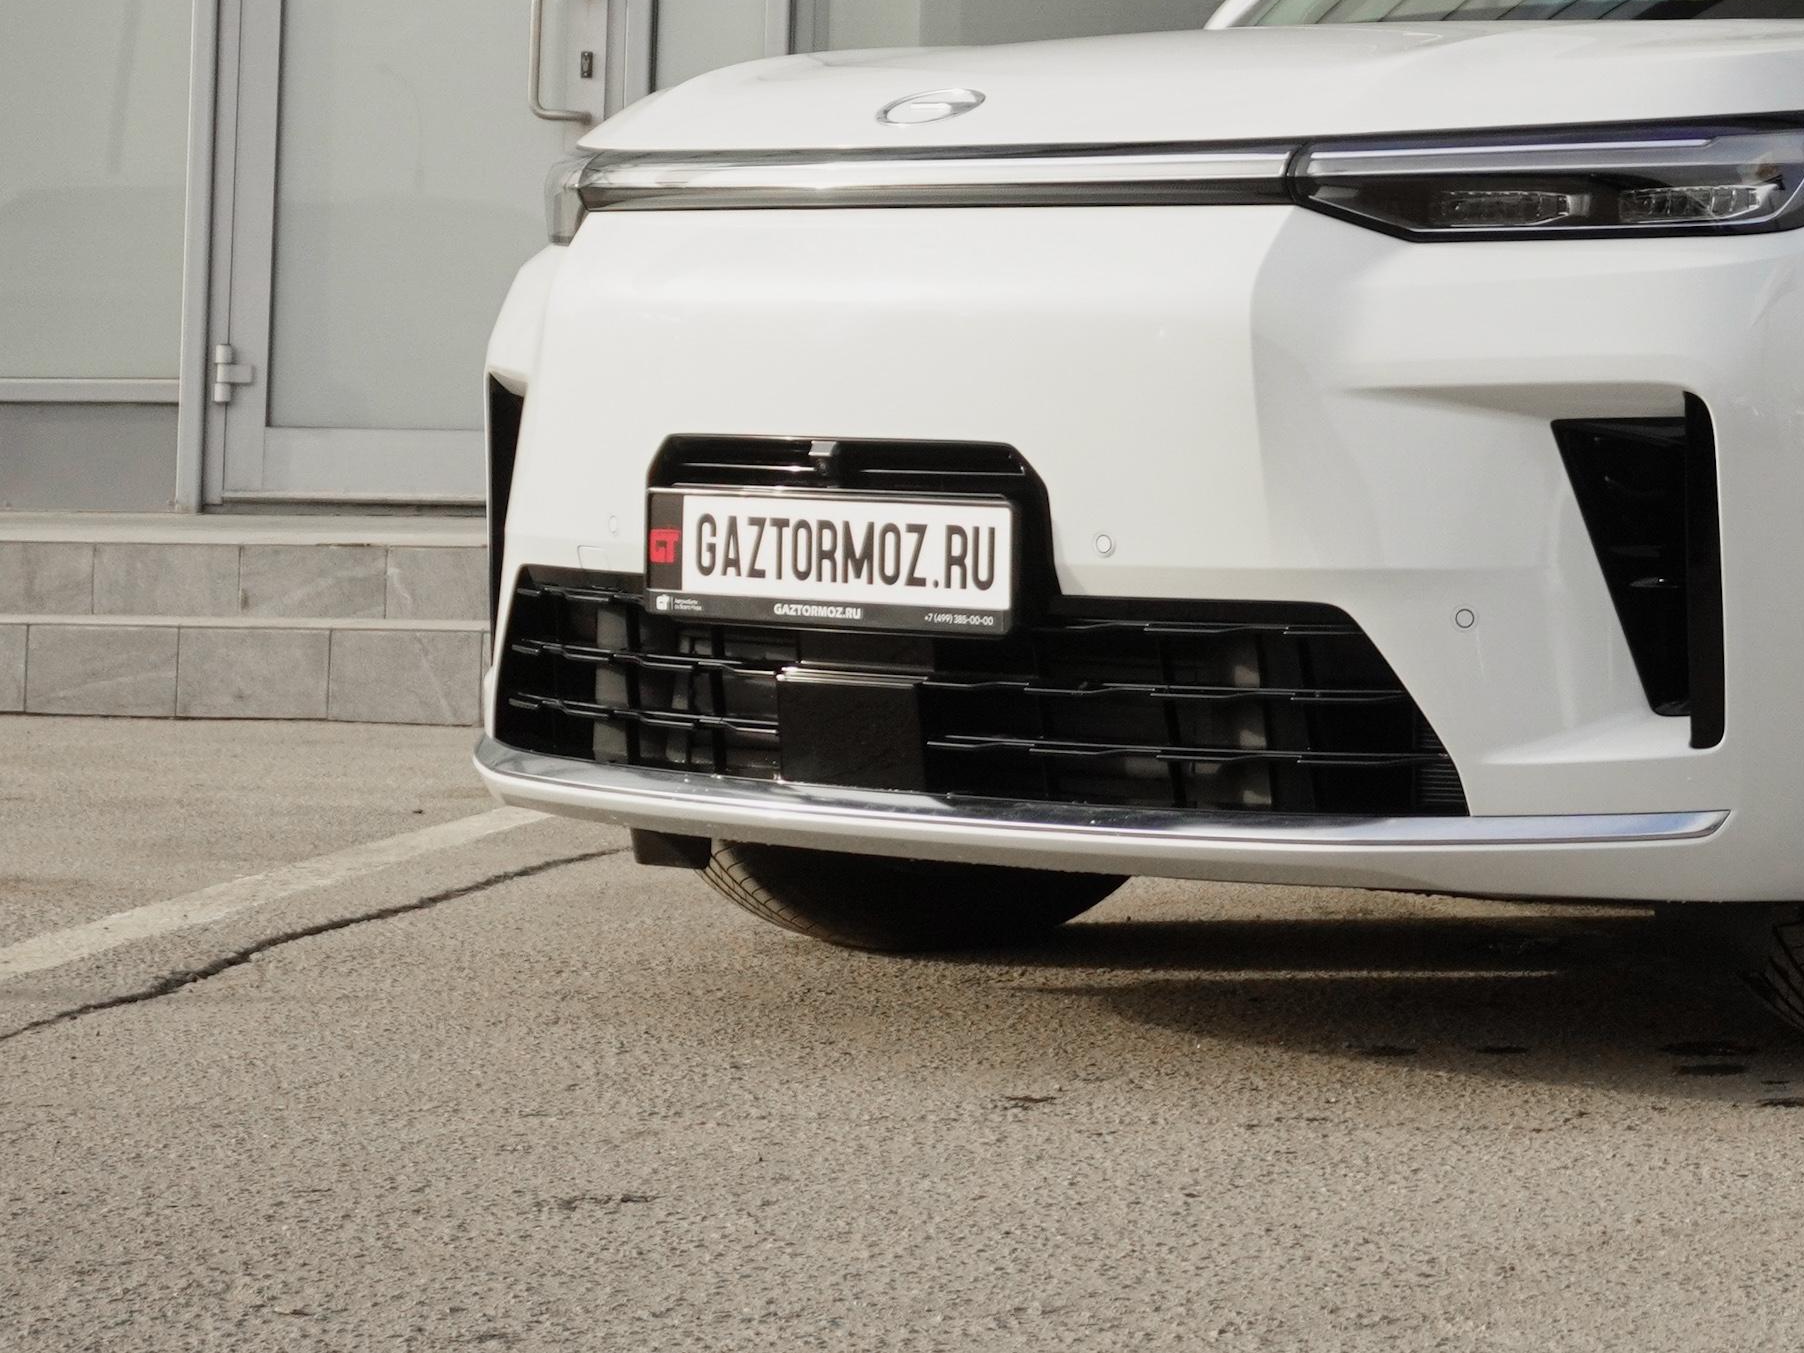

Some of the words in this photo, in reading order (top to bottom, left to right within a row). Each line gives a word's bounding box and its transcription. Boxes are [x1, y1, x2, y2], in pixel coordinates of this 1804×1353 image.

[695, 512, 996, 591] GAZTORMOZ.RU
[773, 602, 862, 620] GAZTORMOZ.RU
[924, 612, 933, 623] +7
[934, 613, 952, 624] (499)
[953, 614, 994, 626] 385-00-00
